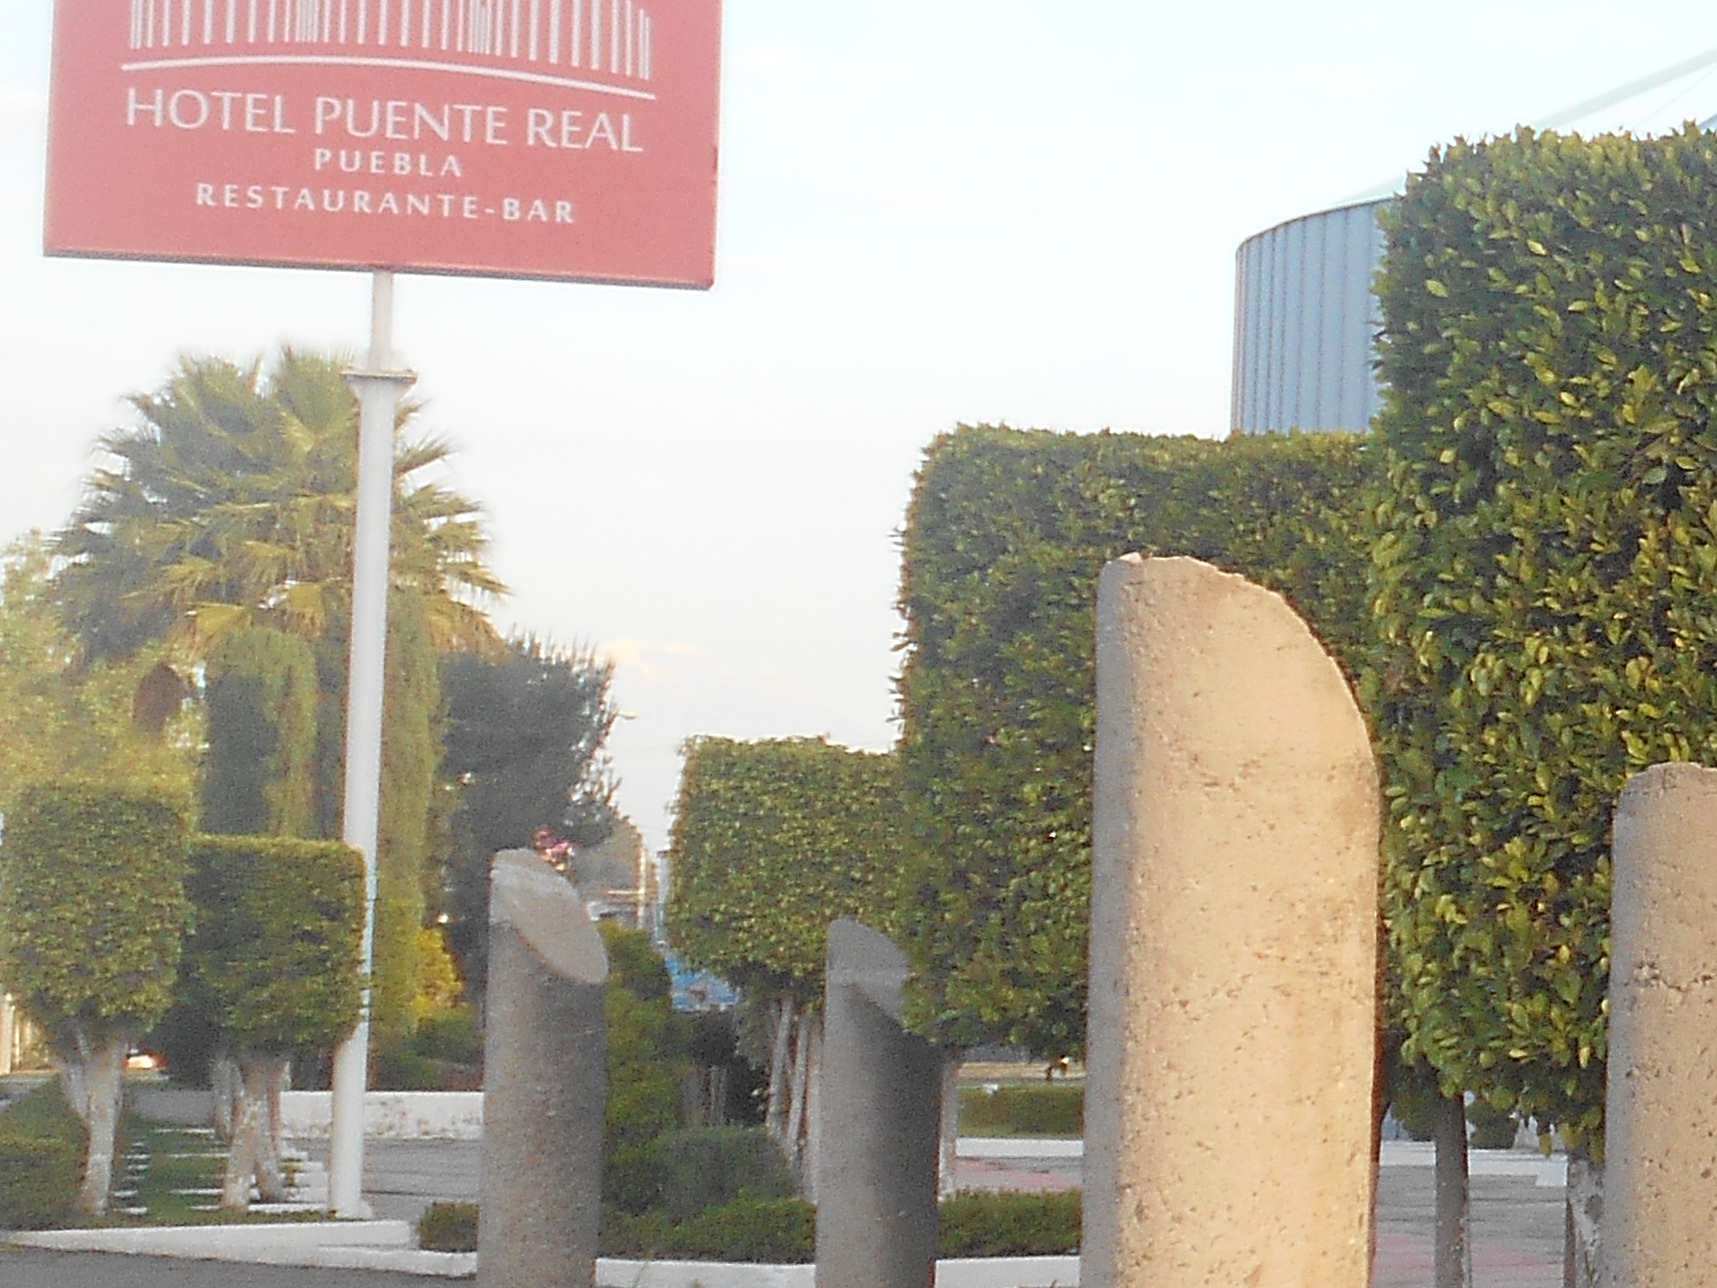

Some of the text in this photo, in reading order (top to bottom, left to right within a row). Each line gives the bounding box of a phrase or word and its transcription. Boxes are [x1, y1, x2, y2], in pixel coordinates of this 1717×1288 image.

[126, 87, 643, 153] HOTEL PUENTE REAL
[314, 149, 463, 177] PUEBLA
[196, 182, 575, 225] RESTAURANTE-BAR
